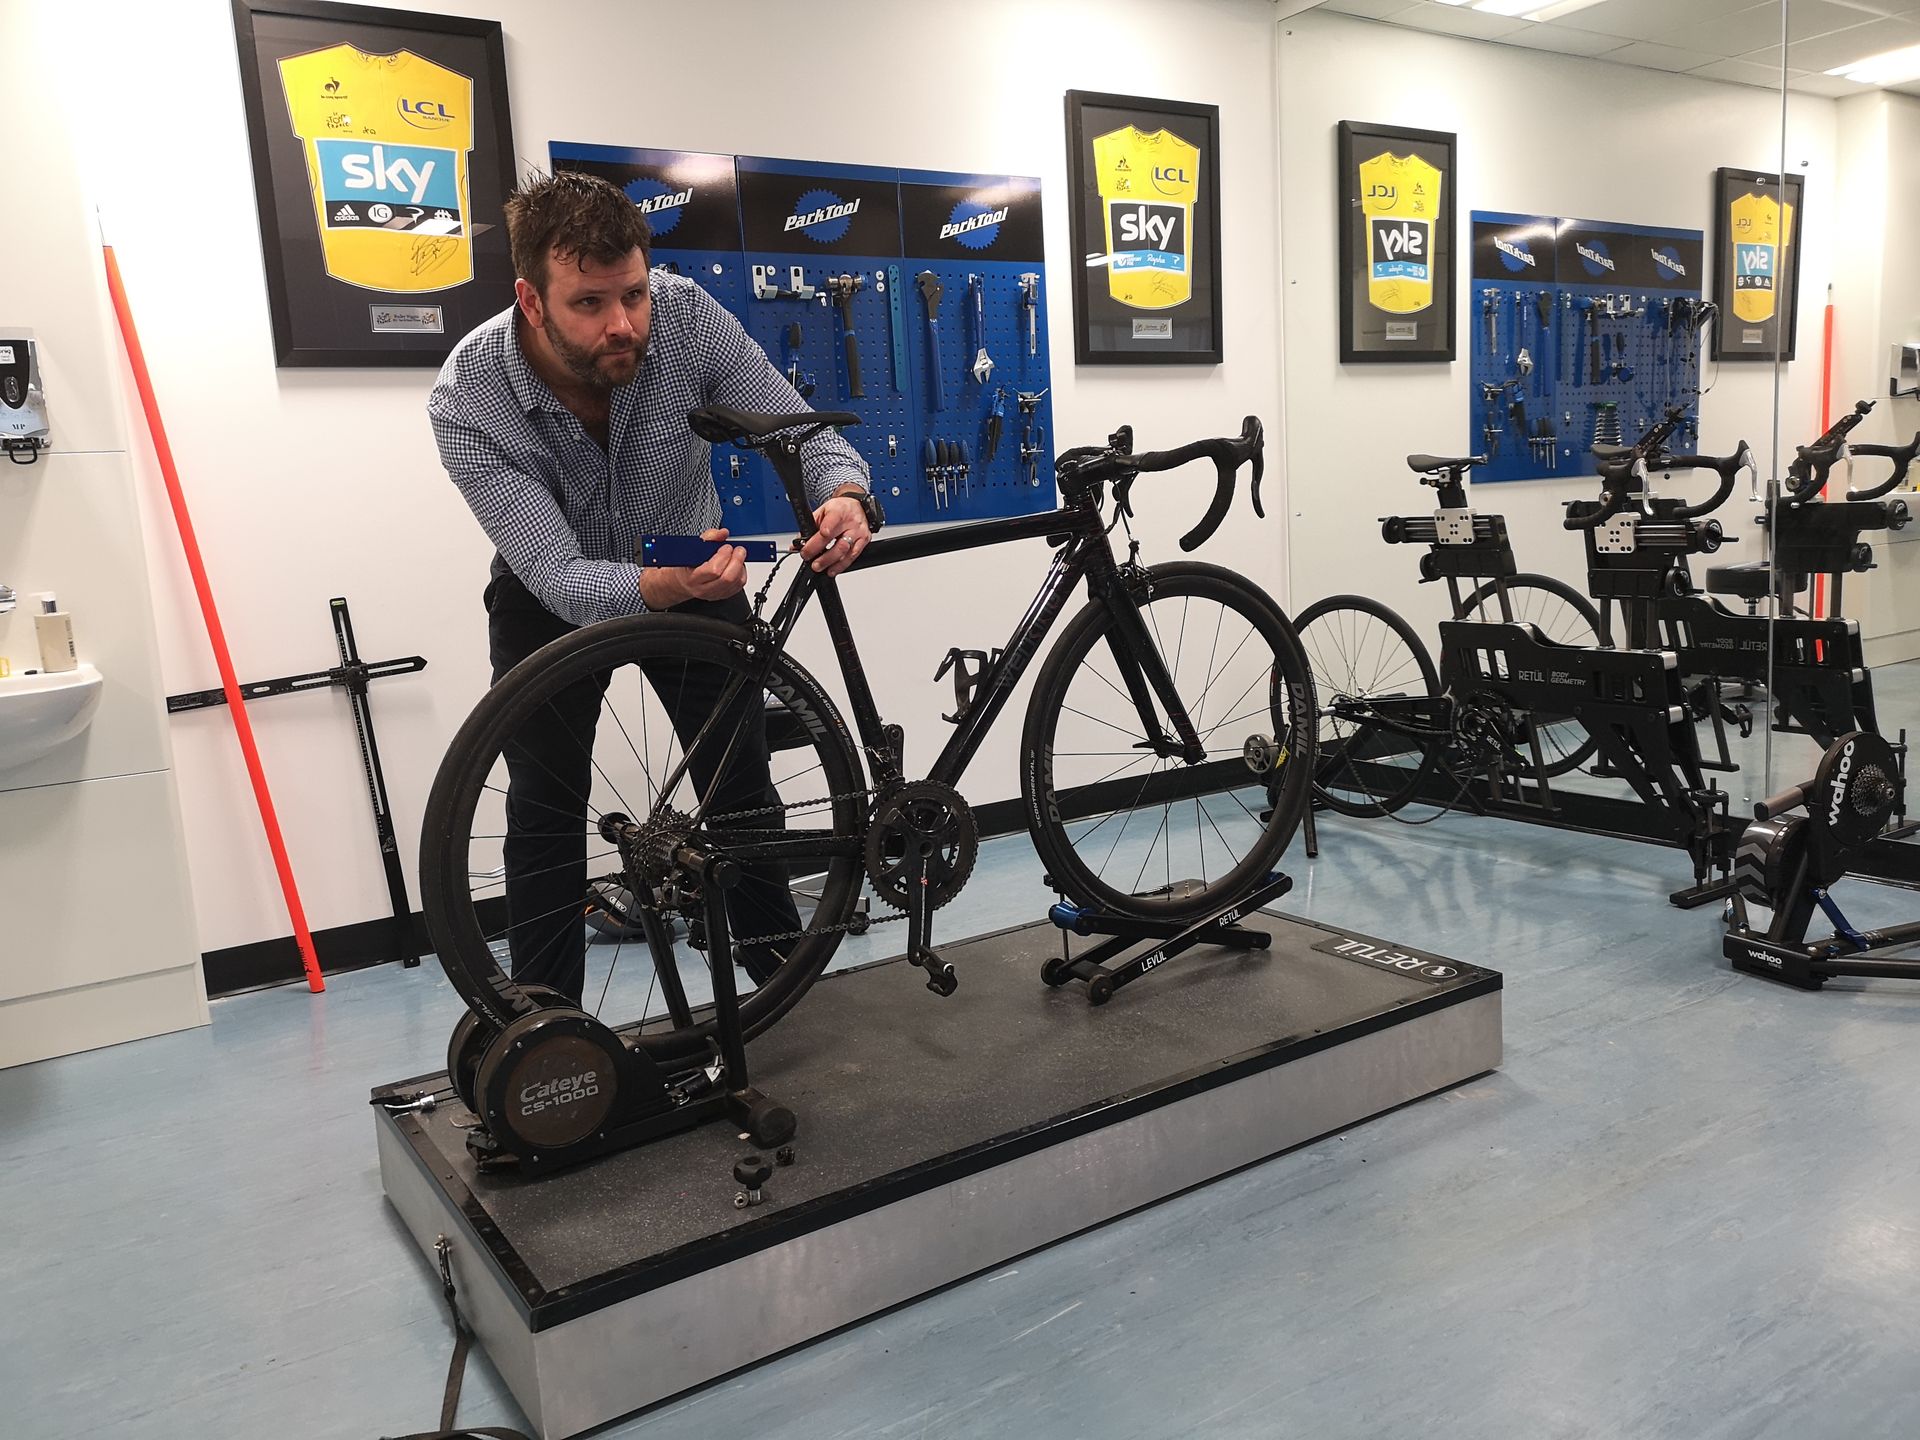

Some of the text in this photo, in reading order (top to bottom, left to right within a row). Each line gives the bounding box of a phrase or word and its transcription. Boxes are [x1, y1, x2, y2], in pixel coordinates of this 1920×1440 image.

[401, 98, 455, 119] LCL
[341, 145, 435, 204] sky
[1155, 167, 1189, 183] LCL
[373, 207, 388, 219] IG
[635, 187, 693, 214] kTool
[1120, 205, 1176, 251] sky
[807, 681, 823, 699] PRIX
[1550, 677, 1586, 686] GEOMETRY
[1291, 682, 1309, 759] DAMIL
[1828, 740, 1855, 826] wahoo
[1748, 949, 1782, 965] wahoo
[520, 1070, 597, 1103] Cateye
[521, 1084, 599, 1116] CS-1000
